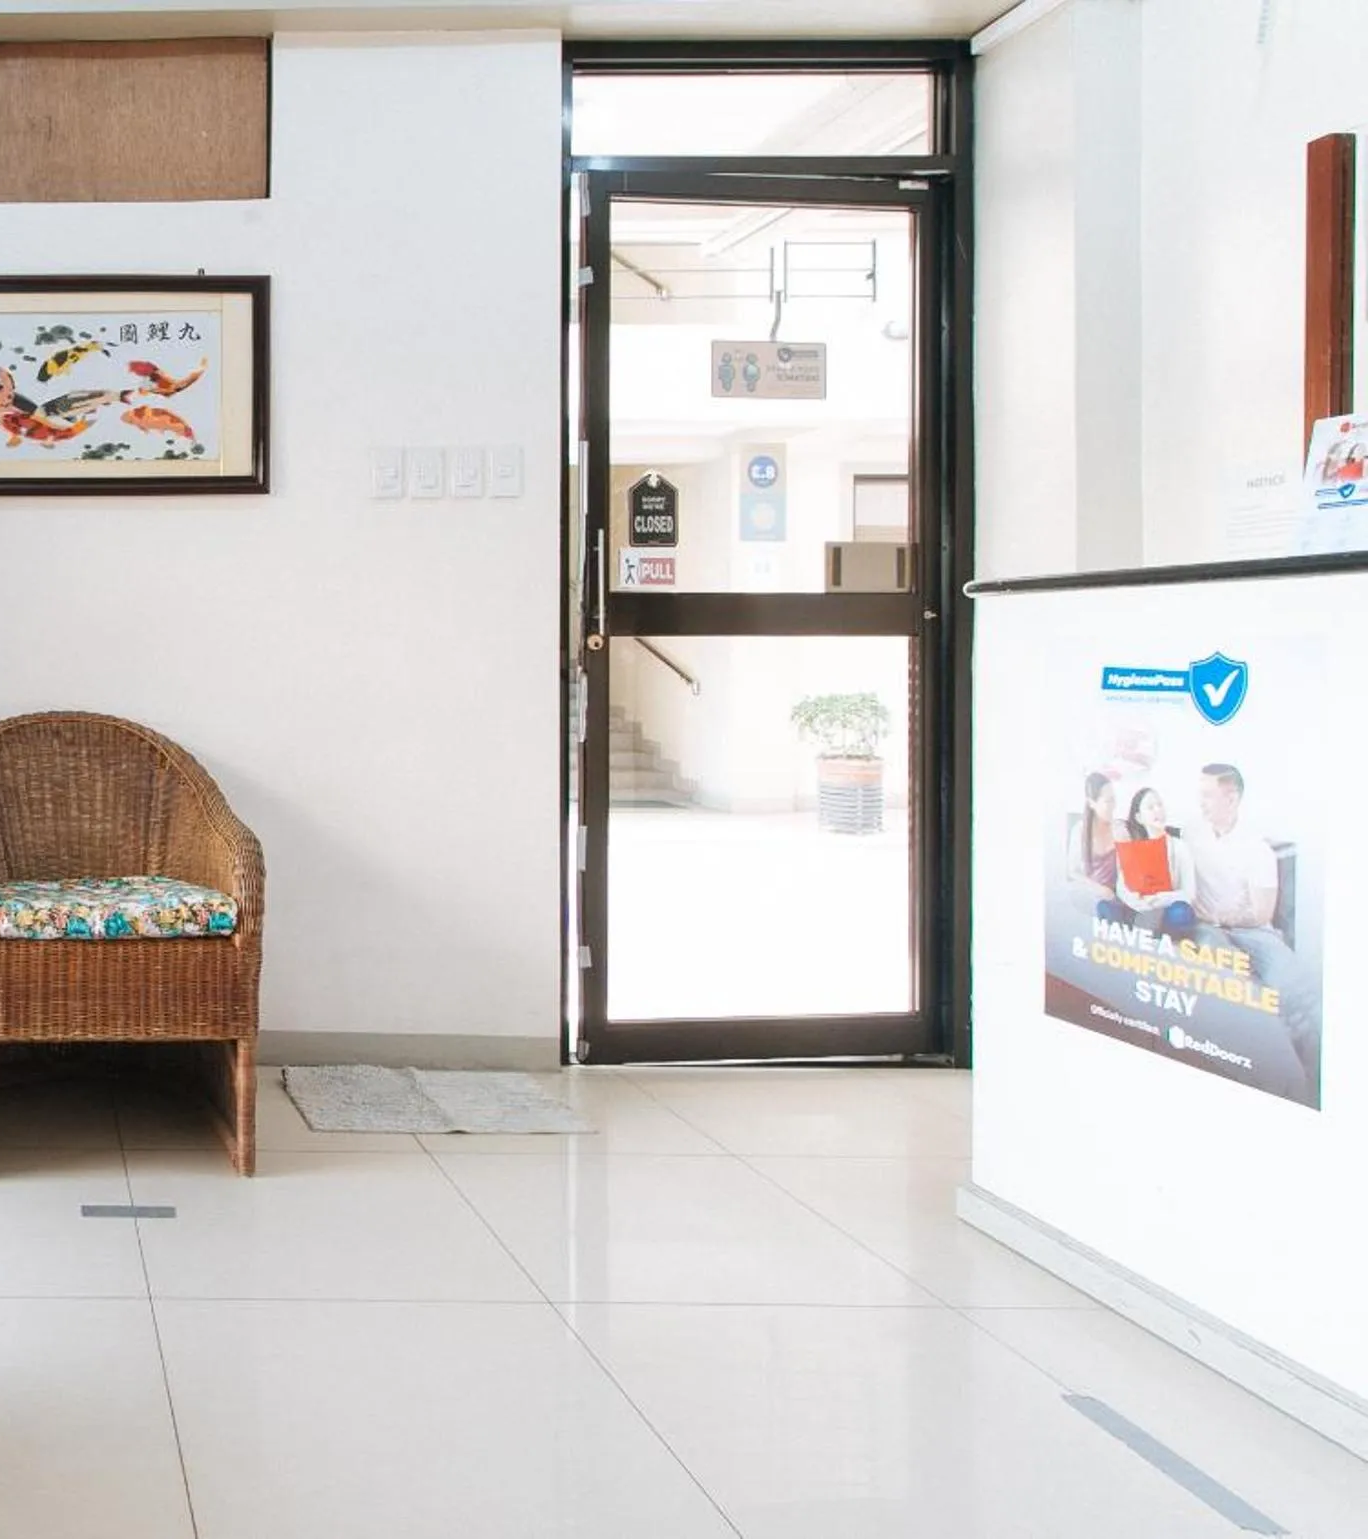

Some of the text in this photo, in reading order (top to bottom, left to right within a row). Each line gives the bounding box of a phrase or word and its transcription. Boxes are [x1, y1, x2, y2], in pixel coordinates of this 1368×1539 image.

[634, 515, 674, 533] CLOSED
[642, 562, 673, 580] PULL
[1093, 917, 1251, 976] HAVE A SAFE
[1072, 936, 1280, 1015] & COMFORTABLE
[1135, 980, 1198, 1017] STAY
[1184, 1034, 1253, 1069] RedDoorz
